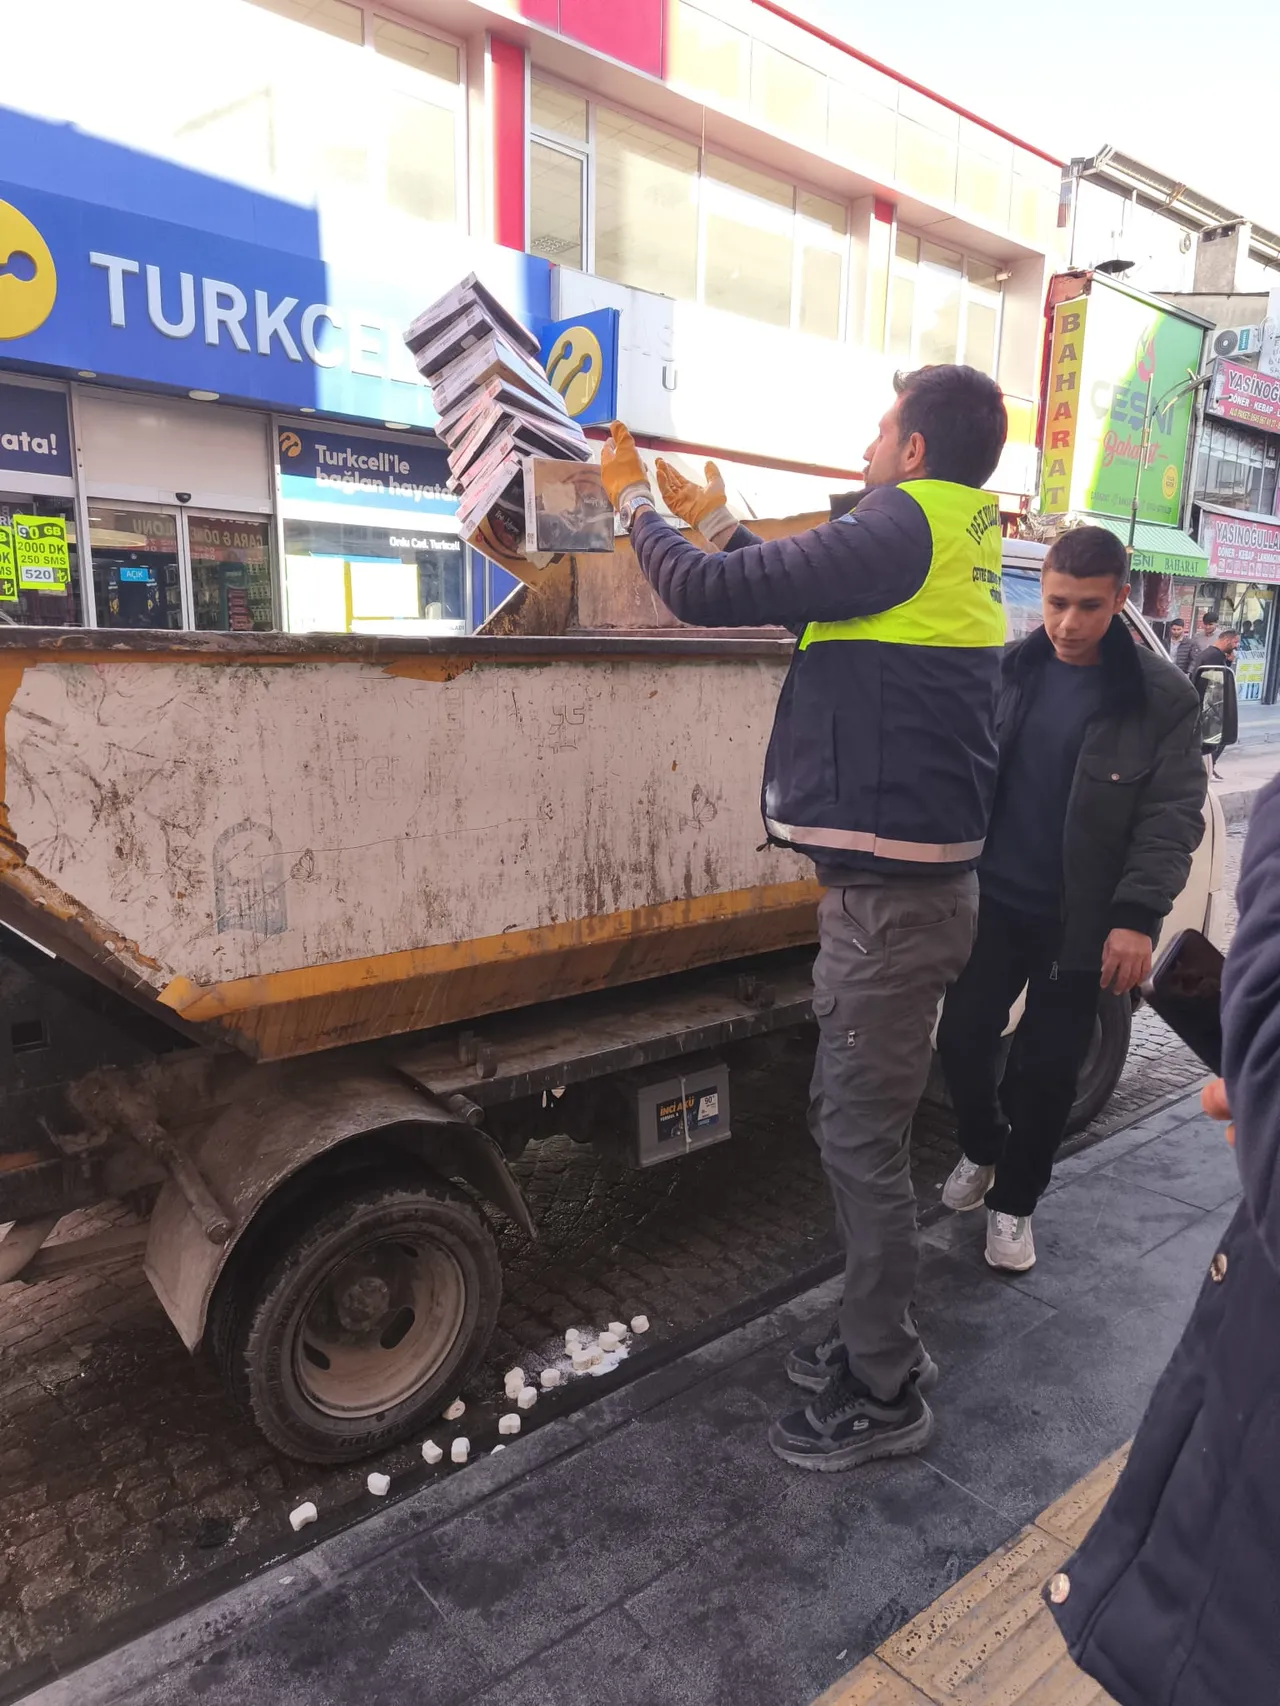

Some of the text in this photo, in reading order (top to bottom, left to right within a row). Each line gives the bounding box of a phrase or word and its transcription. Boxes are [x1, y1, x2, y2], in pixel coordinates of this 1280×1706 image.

[1228, 369, 1280, 405] YASİNOĞ
[1046, 312, 1081, 505] BAHARAT
[1254, 401, 1275, 415] KEBAP
[0, 431, 57, 456] ata!
[315, 444, 410, 475] Turkcell'le
[315, 466, 385, 495] bağlan
[389, 475, 458, 503] hayata
[17, 525, 62, 539] 90 GB
[1215, 520, 1280, 551] YASİNOĞULLA
[17, 541, 65, 555] 2000 DK
[429, 538, 461, 551] Turkcell
[21, 555, 67, 566] 250 SMS
[1164, 558, 1200, 574] BAHARAT
[25, 569, 51, 580] 520
[126, 571, 143, 579] AÇIK
